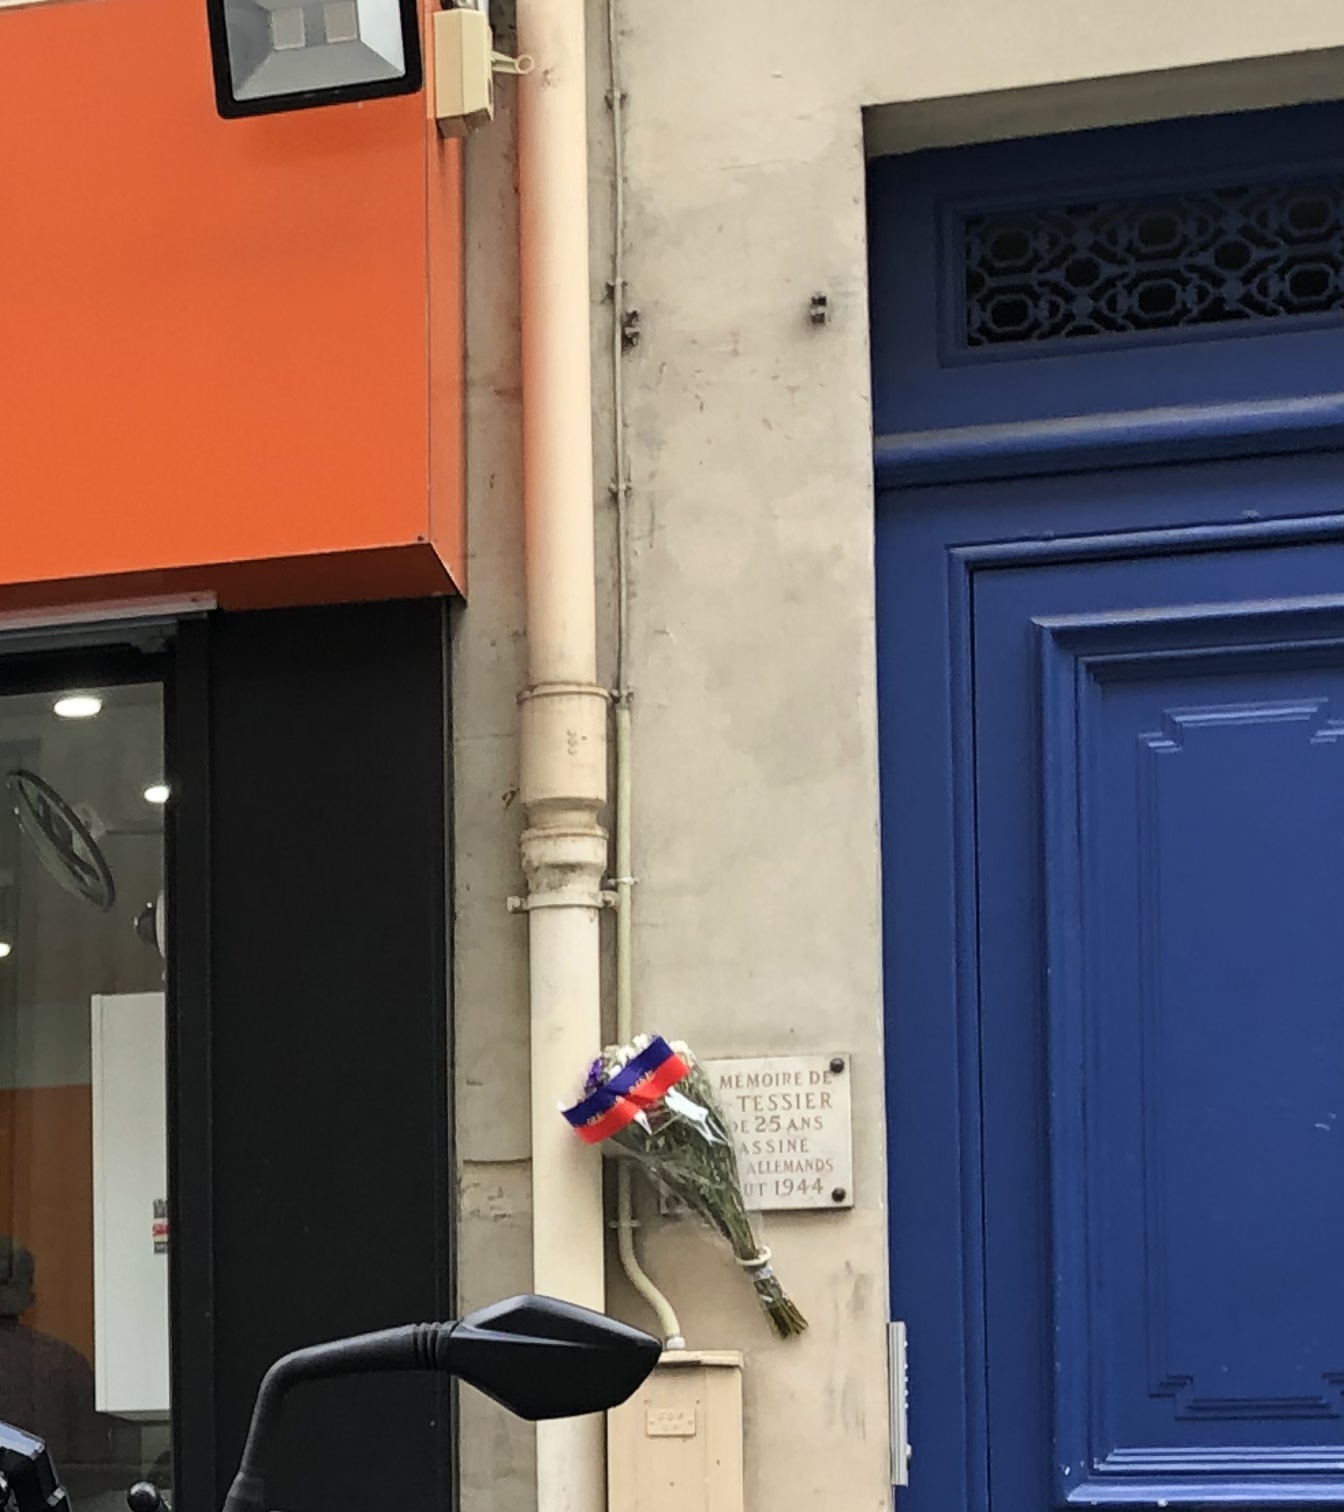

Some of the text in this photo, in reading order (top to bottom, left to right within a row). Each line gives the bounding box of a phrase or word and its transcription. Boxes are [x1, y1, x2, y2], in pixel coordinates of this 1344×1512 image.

[808, 1070, 833, 1086] DE
[735, 1090, 833, 1113] TESSIER
[754, 1115, 782, 1134] 25
[786, 1114, 824, 1133] ANS
[774, 1177, 825, 1197] 1944
